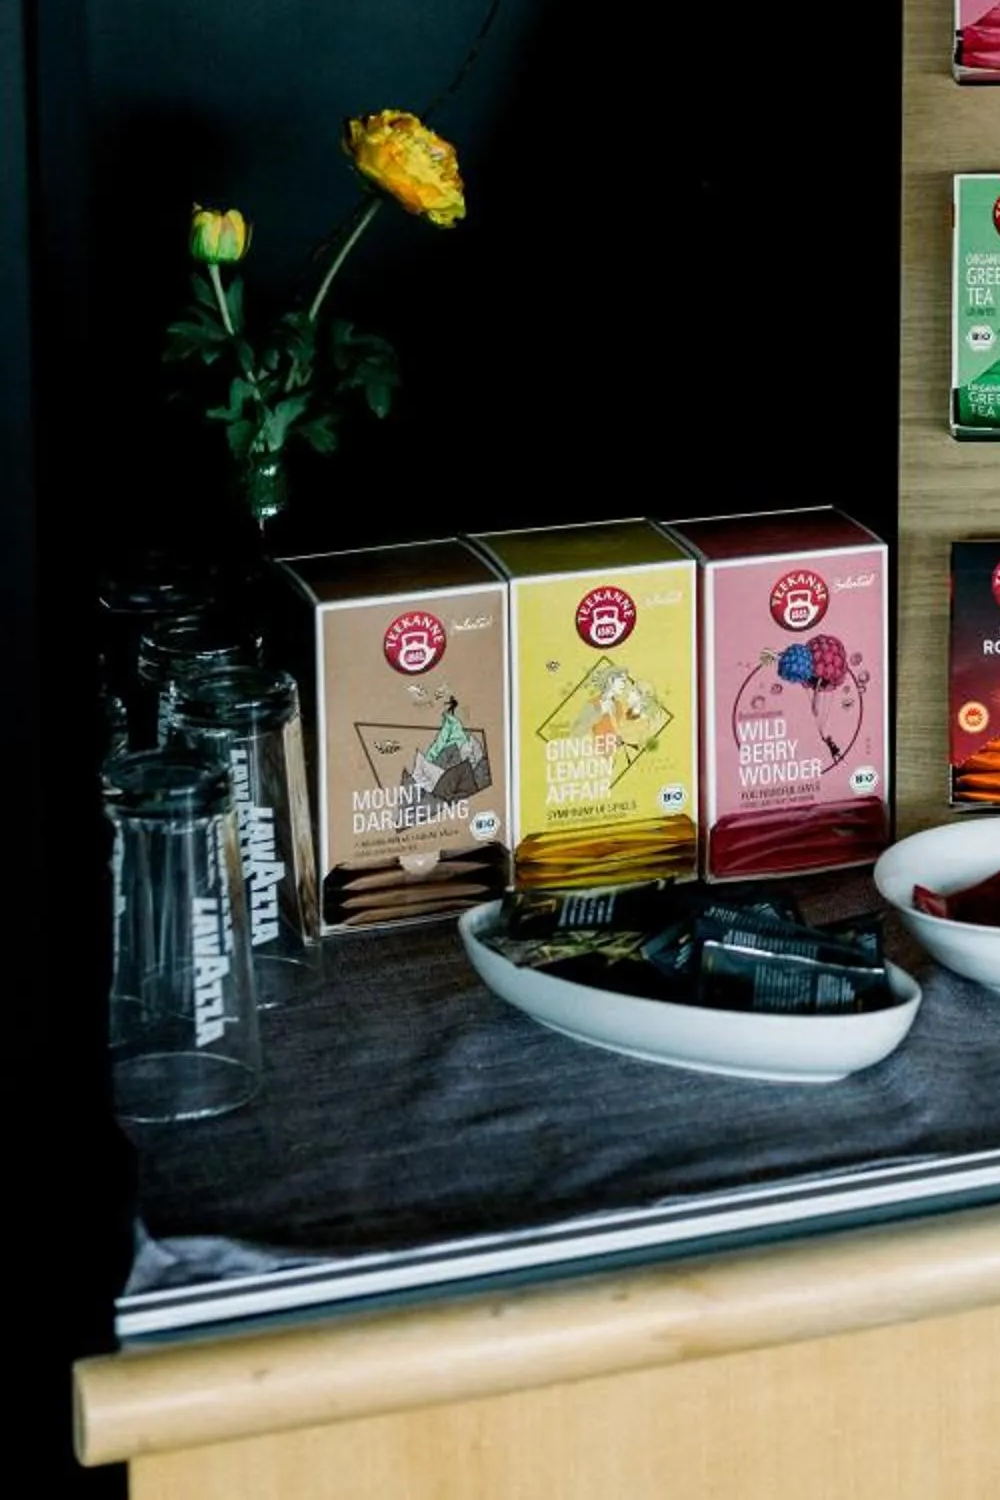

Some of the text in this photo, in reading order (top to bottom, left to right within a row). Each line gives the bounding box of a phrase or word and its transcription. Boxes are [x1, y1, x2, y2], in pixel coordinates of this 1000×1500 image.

[967, 287, 995, 305] TEA
[971, 404, 997, 417] TEA
[772, 572, 828, 607] TEEKANNE
[578, 588, 635, 623] TEEKANNE
[385, 614, 445, 649] TEEKANNE
[738, 718, 787, 742] WILD
[545, 734, 620, 762] GINGER
[738, 738, 799, 765] BERRY
[545, 756, 614, 784] LEMON
[738, 760, 822, 788] WONDER
[352, 783, 425, 812] MOUNT
[545, 778, 612, 806] AFFAIR
[352, 799, 469, 834] DARJEELING
[250, 806, 286, 948] LAVAZZA
[192, 897, 230, 1048] LAVAZZA
